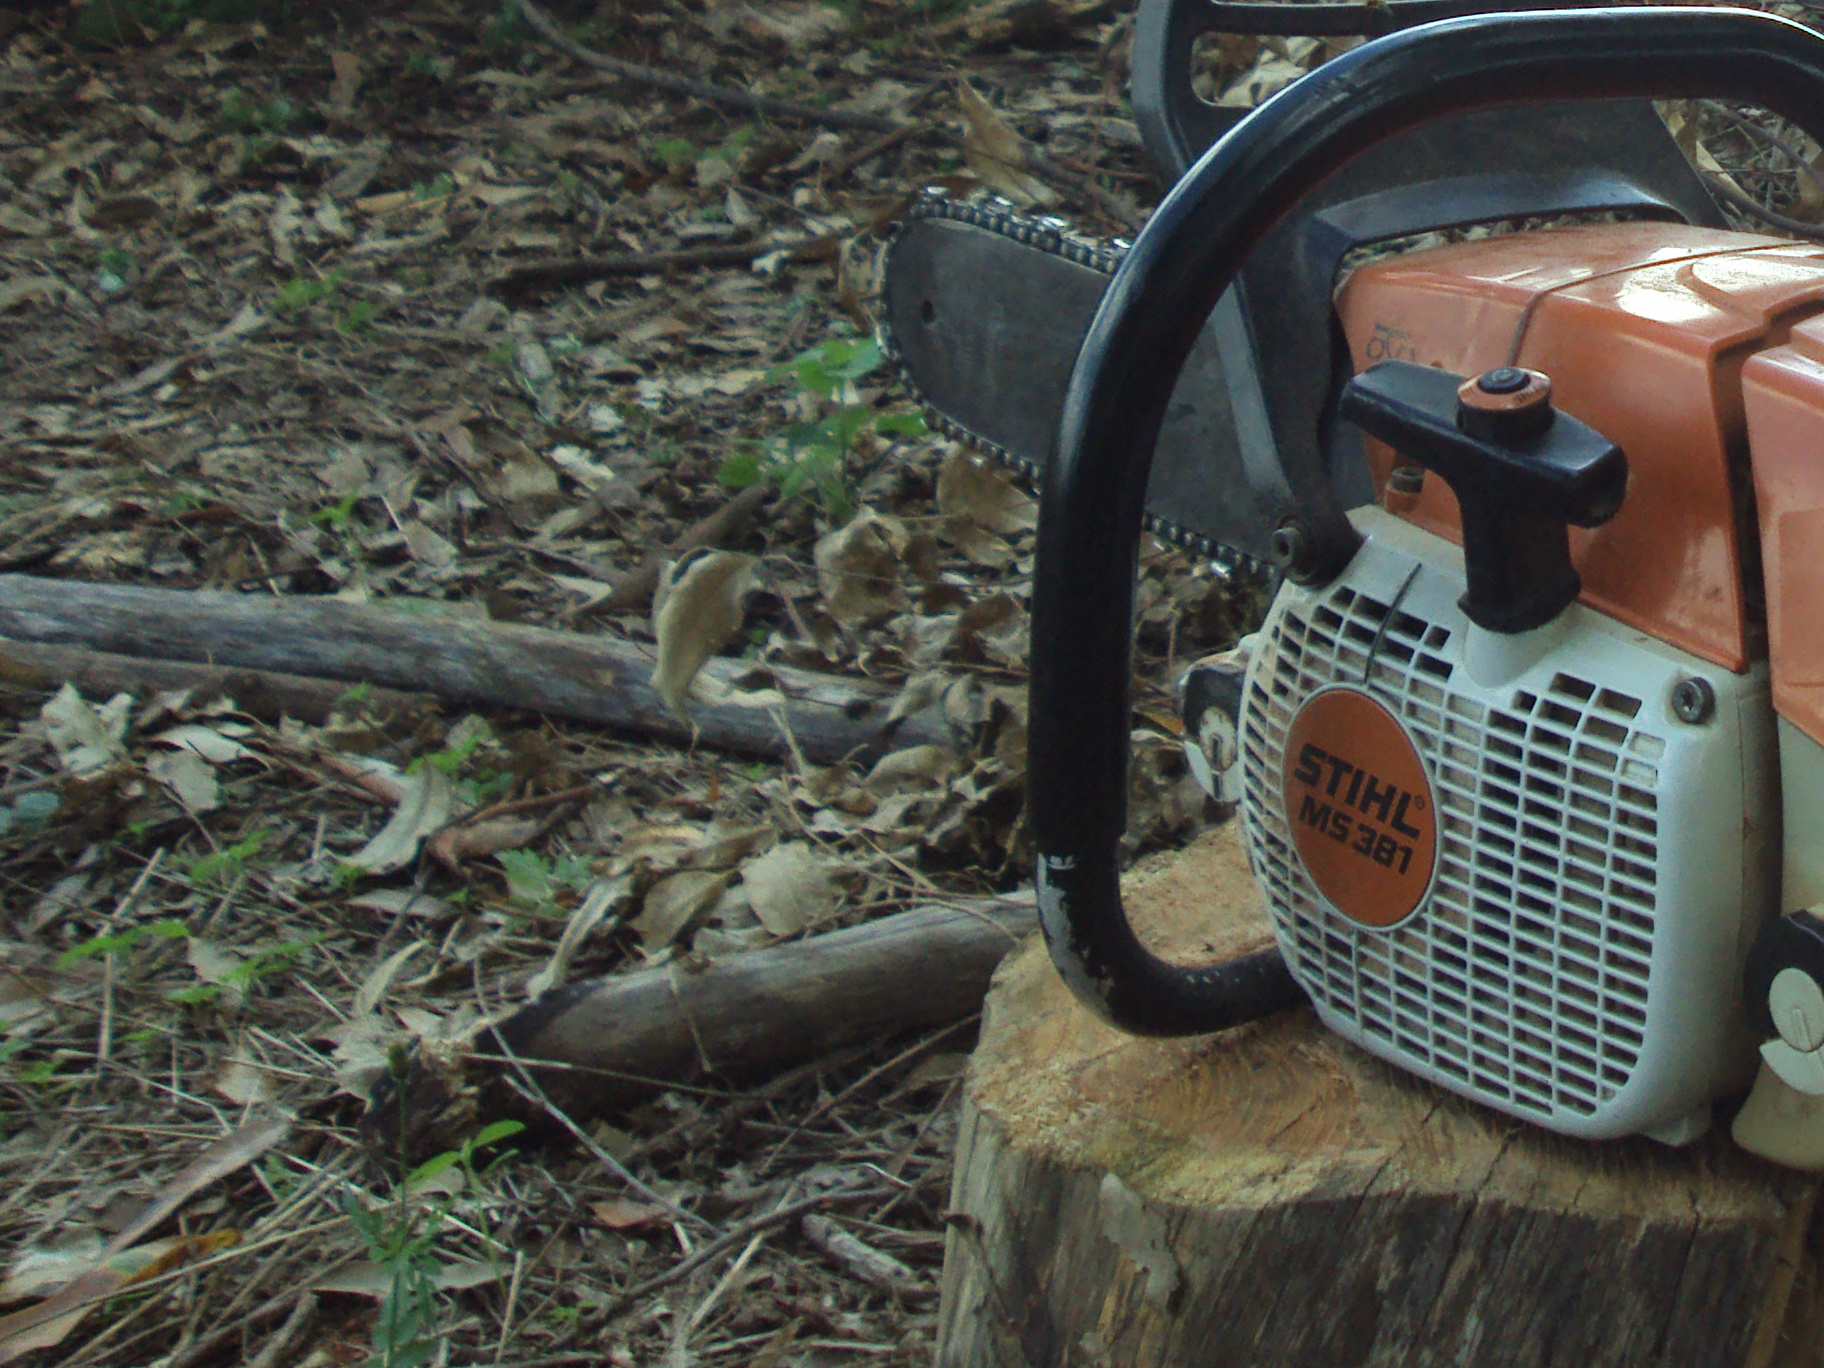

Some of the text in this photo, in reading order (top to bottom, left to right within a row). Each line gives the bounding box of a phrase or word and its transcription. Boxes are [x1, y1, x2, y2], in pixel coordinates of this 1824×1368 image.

[1294, 743, 1421, 839] STIHL
[1299, 795, 1414, 875] MS 381
